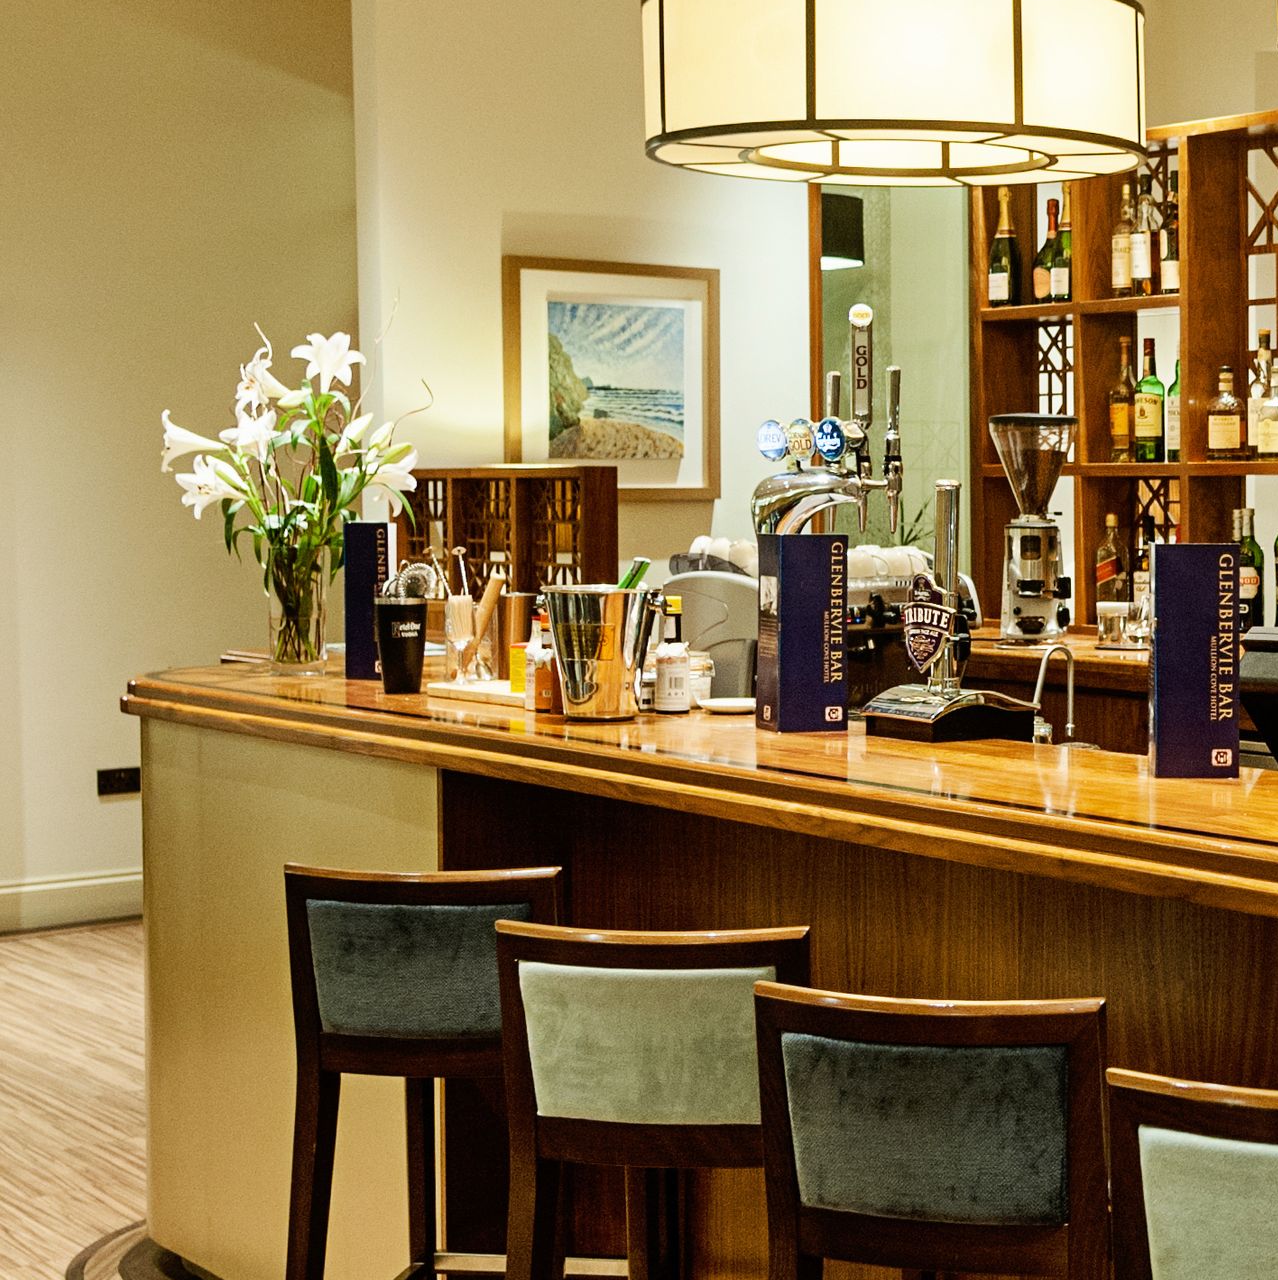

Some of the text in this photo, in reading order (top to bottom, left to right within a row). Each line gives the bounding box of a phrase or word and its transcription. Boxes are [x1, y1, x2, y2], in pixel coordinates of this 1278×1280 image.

[856, 345, 868, 390] GOLD
[788, 439, 812, 451] GOLD
[830, 541, 844, 683] GLENBERVIE BAR
[903, 607, 950, 629] TRIBUTE
[1218, 553, 1234, 721] GLENBERVIE BAR
